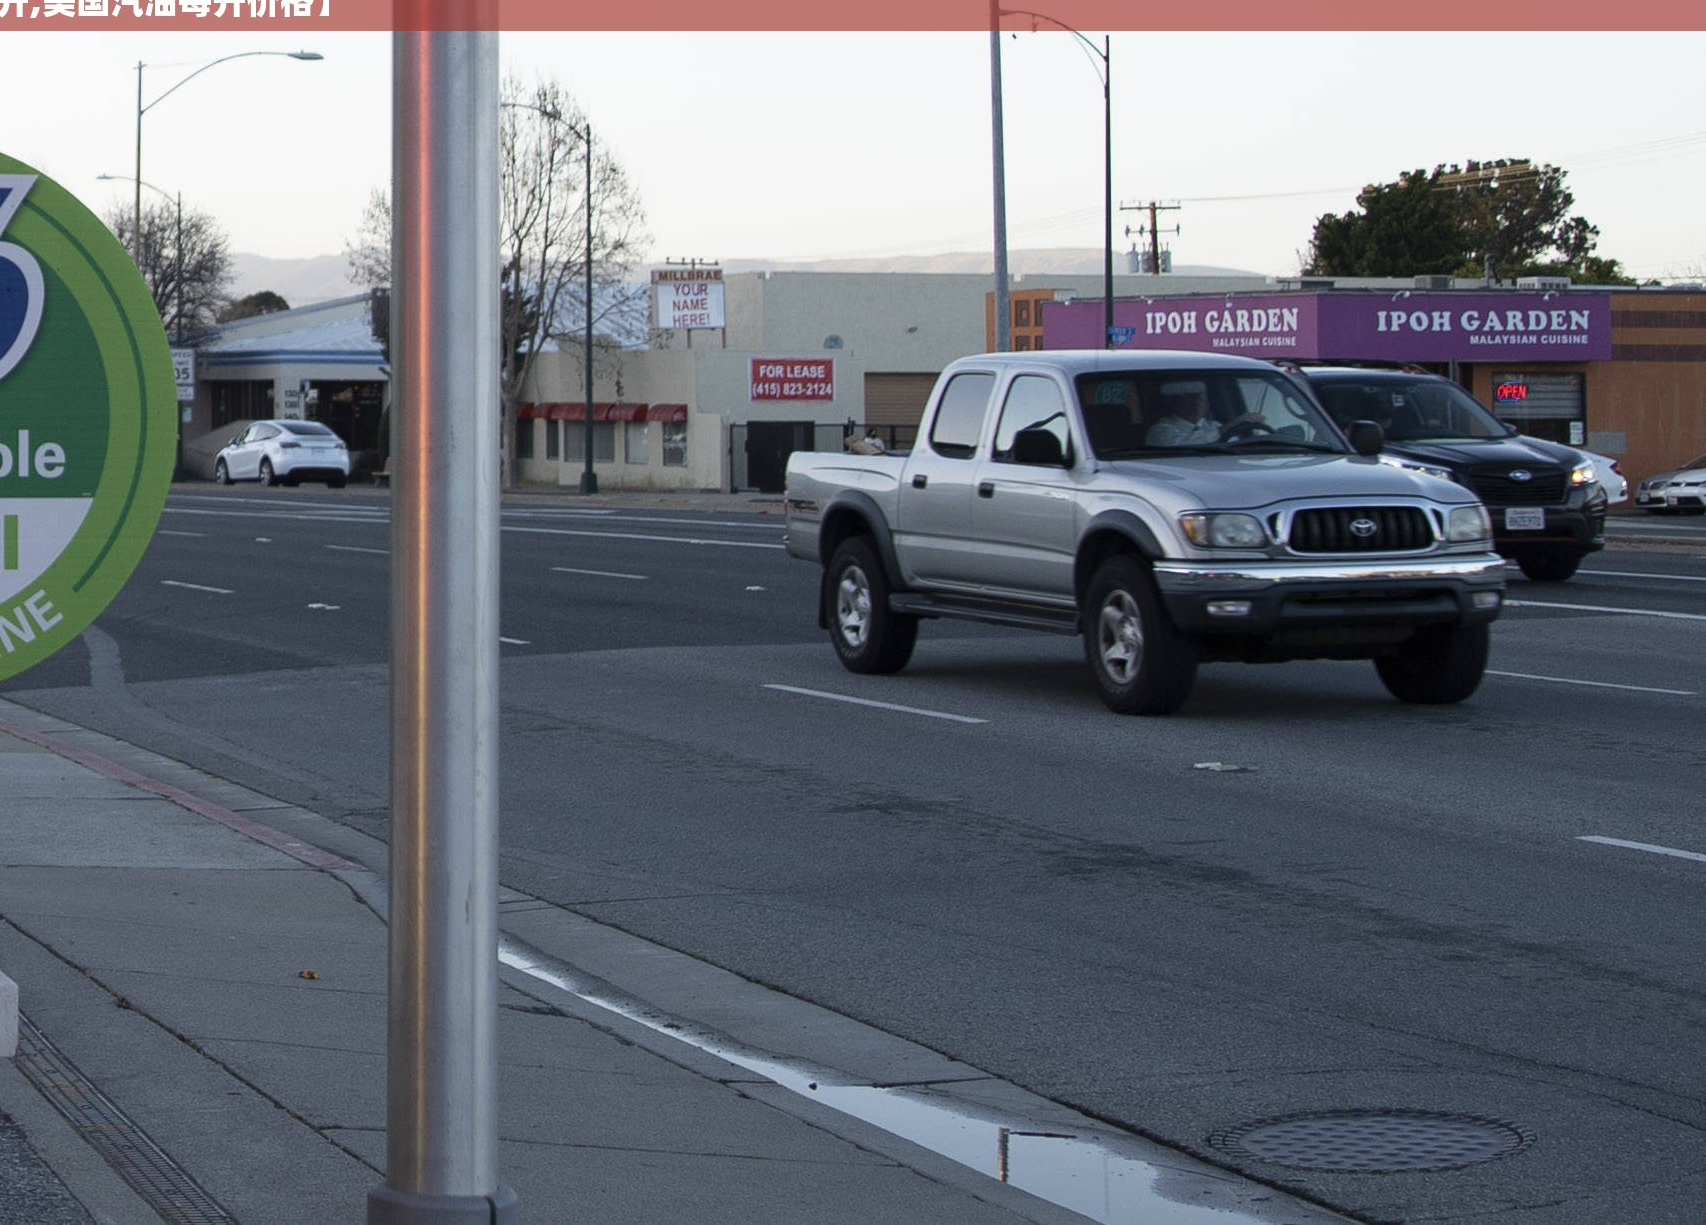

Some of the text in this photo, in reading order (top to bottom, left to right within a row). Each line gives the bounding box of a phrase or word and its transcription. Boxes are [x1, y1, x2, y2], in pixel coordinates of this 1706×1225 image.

[658, 270, 722, 282] MILLBRAE
[673, 283, 709, 296] YOUR
[672, 298, 709, 311] NAME
[673, 313, 710, 327] HERE!
[1145, 311, 1197, 334] IPOH
[1204, 308, 1298, 333] GARDEN
[1377, 310, 1590, 331] IPOH GARDEN
[1212, 336, 1297, 347] MALAYSIAN CUISINE
[1469, 335, 1589, 345] MALAYSIAN CUISINE
[759, 365, 826, 378] FOR LEASE
[752, 382, 832, 397] (415) 823-2124
[1497, 384, 1527, 399] OPEN
